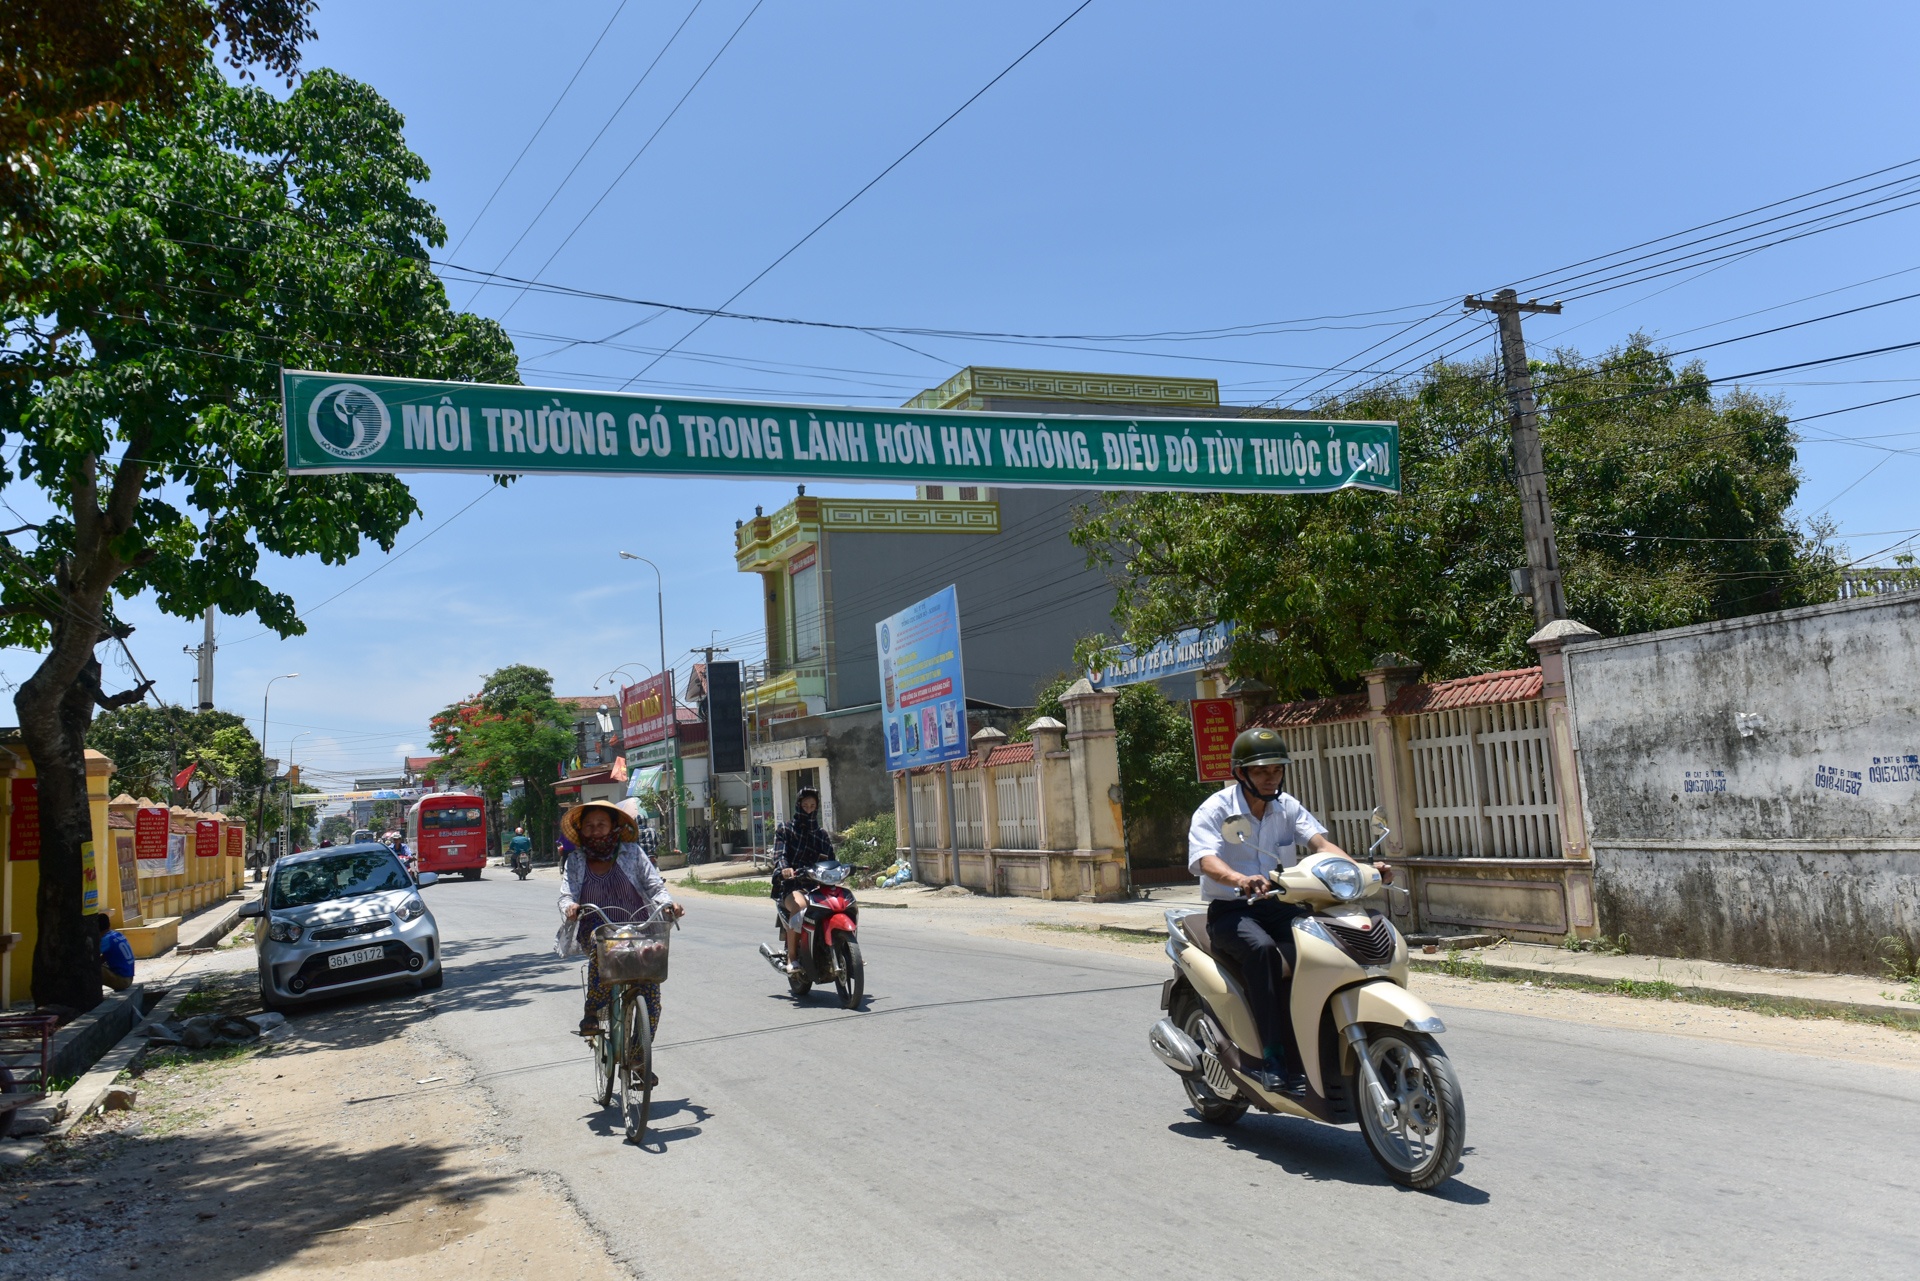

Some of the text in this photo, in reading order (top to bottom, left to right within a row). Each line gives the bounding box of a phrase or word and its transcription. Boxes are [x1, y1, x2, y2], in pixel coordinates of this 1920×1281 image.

[401, 397, 472, 451] MÔI
[481, 398, 619, 455] TRƯỜNG
[628, 406, 672, 457] CÓ
[678, 414, 784, 460] TRONG
[789, 412, 869, 462] LÀNH
[874, 421, 936, 465] HƠN
[940, 426, 993, 466] HAY
[1000, 422, 1098, 475] KHÔNG,
[1102, 420, 1160, 472] ĐIỀU
[1164, 428, 1198, 473] ĐÓ
[1202, 430, 1243, 475] TÙY
[1250, 432, 1321, 484] THUỘC
[1327, 426, 1343, 477] Ở
[320, 440, 331, 450] MÔI
[368, 440, 381, 452] NAM
[1109, 657, 1138, 678] TRẠM
[1140, 656, 1147, 671] Y
[1148, 645, 1160, 670] TẾ
[1161, 645, 1175, 666] XÃ
[1177, 642, 1204, 663] MINH
[1215, 717, 1224, 725] TỊCH
[1203, 726, 1210, 734] HỒ
[1208, 743, 1220, 752] SỐNG
[1206, 761, 1229, 770] CỦA CHÚNG
[330, 948, 383, 967] 36A-191.72
